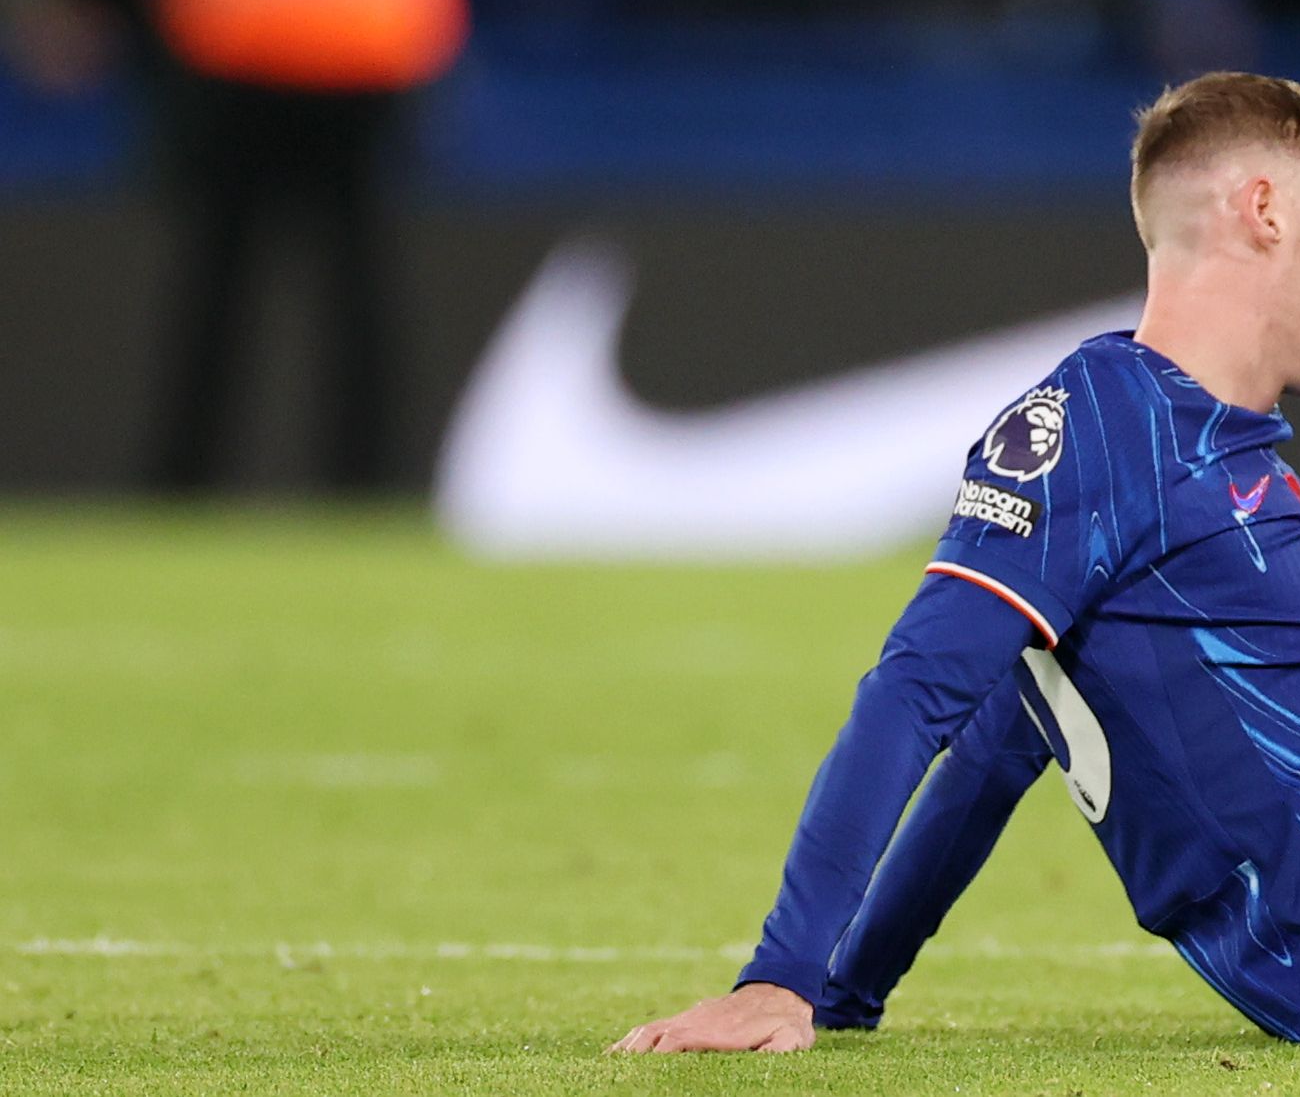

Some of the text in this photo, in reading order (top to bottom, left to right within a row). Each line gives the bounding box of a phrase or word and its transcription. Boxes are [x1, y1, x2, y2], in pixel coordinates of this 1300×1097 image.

[959, 479, 1032, 518] No room
[971, 501, 1033, 538] racism
